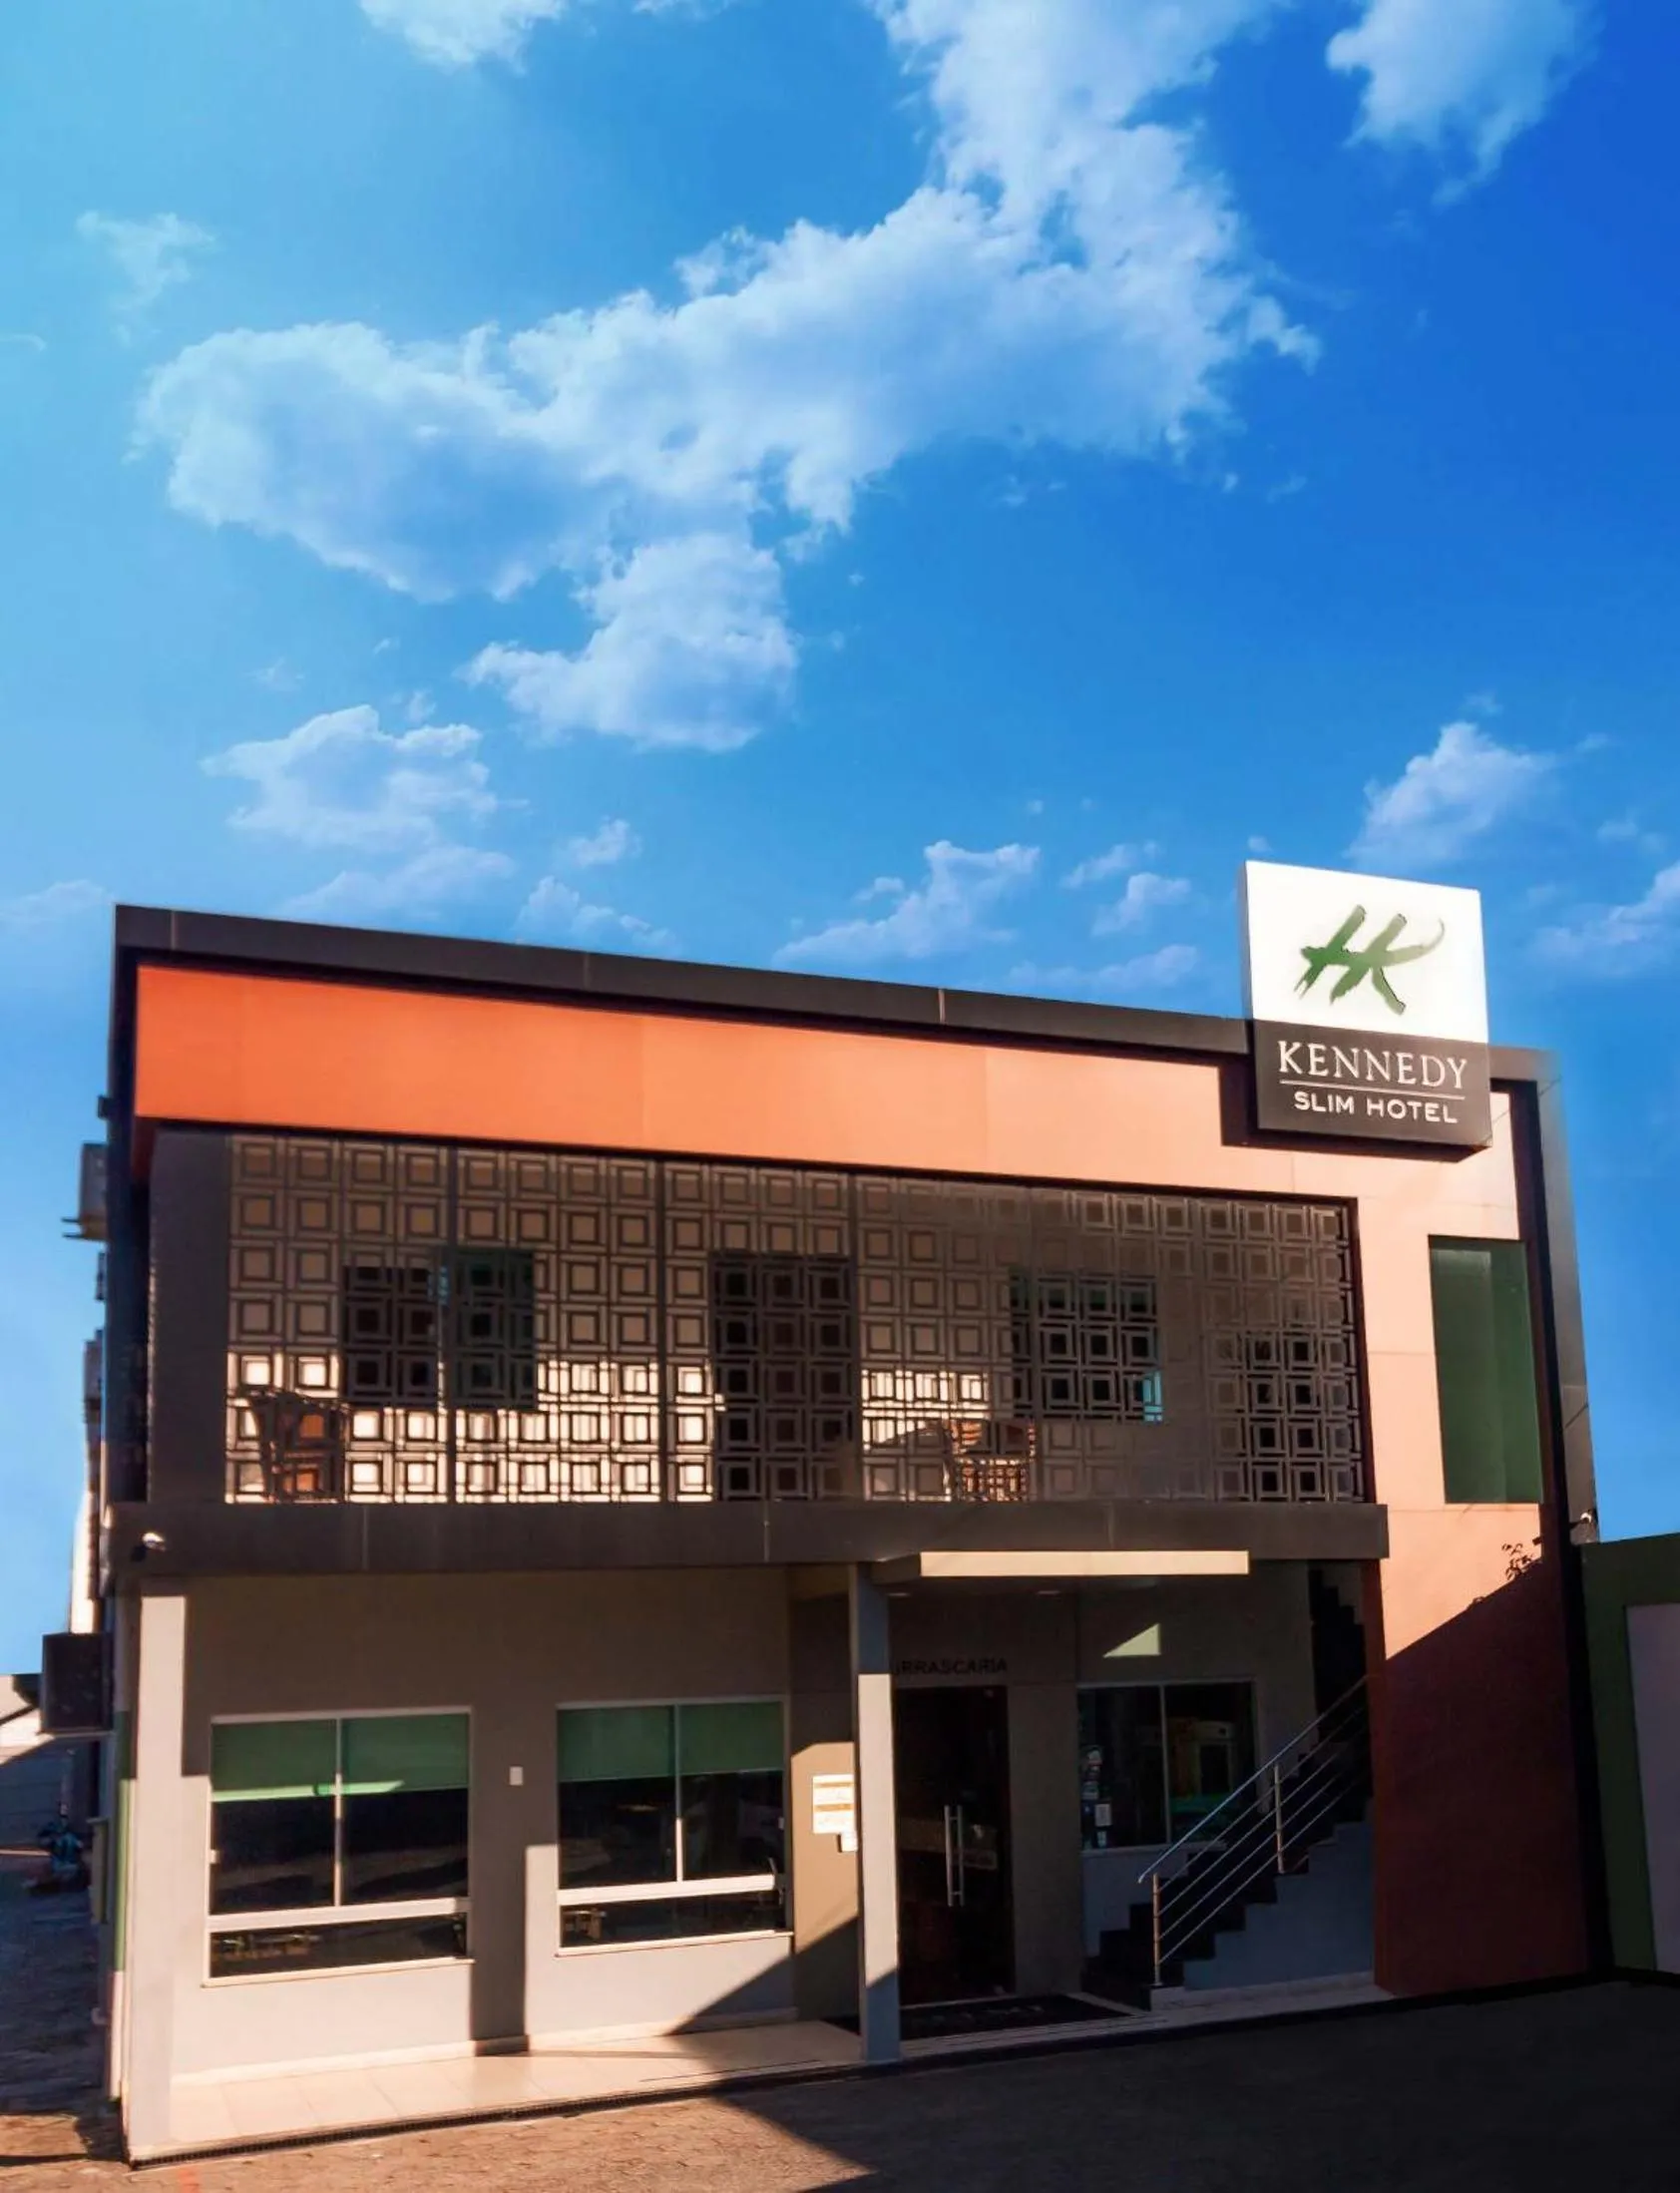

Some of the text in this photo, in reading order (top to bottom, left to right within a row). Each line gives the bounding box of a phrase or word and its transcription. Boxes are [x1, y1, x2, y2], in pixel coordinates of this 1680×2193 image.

[1278, 1040, 1468, 1090] KENNEDY
[1294, 1091, 1459, 1124] SLIM HOTEL
[896, 1656, 1009, 1676] RRASCARIA
